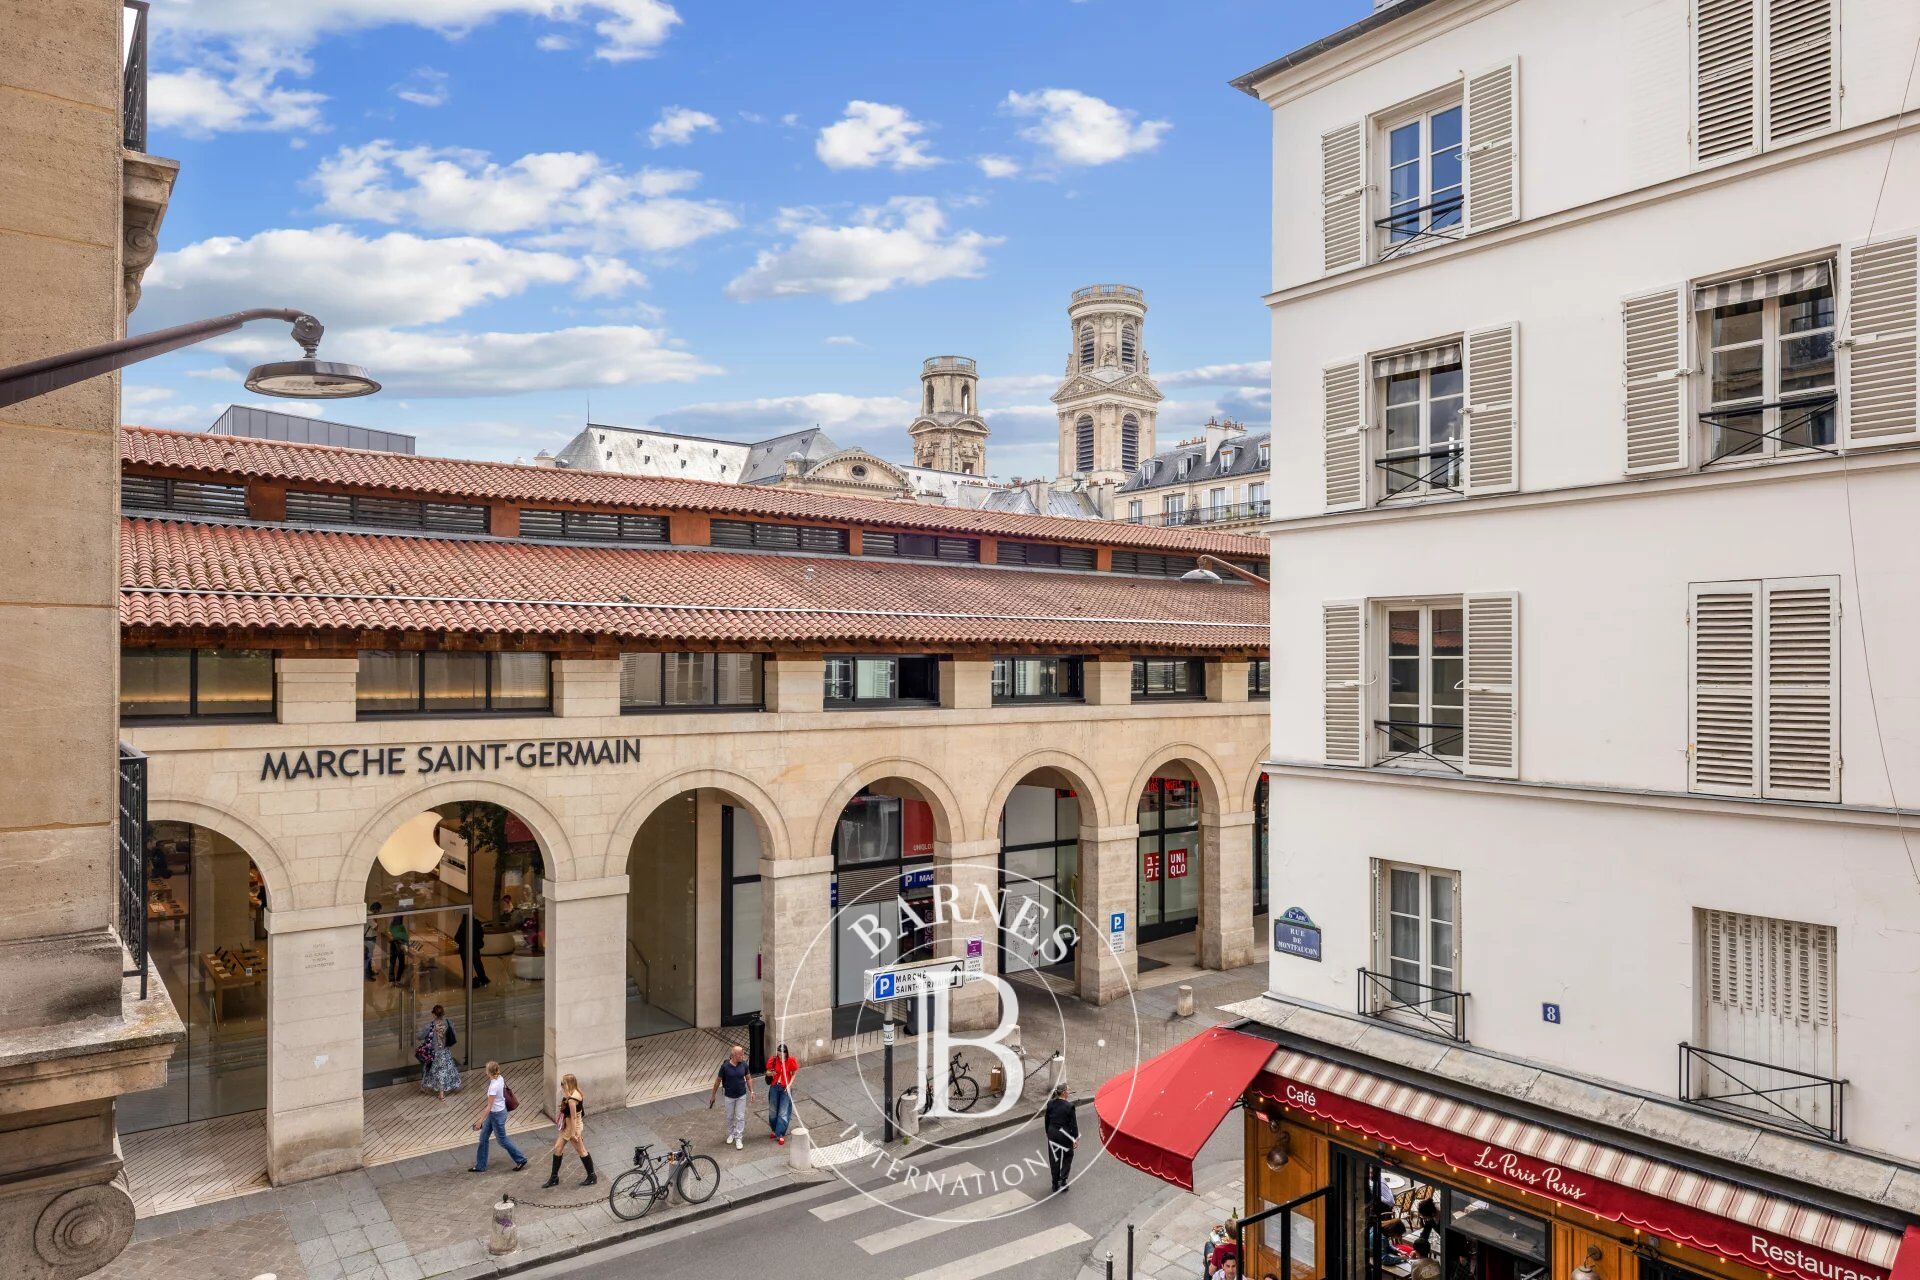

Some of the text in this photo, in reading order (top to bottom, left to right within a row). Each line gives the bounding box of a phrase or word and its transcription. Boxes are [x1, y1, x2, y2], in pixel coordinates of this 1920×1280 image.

[260, 737, 642, 782] MARCHE SAINT-GERMAIN
[1170, 853, 1185, 864] UNI
[1170, 863, 1186, 876] QLO
[1114, 916, 1122, 929] P
[1290, 928, 1305, 937] RUE
[1292, 936, 1302, 945] DE
[1277, 941, 1318, 956] MONTFAUCON
[880, 969, 928, 995] P MARCHÉ
[1546, 1006, 1556, 1021] 8
[1286, 1085, 1317, 1107] Café
[1473, 1146, 1587, 1200] Le Paris Paris
